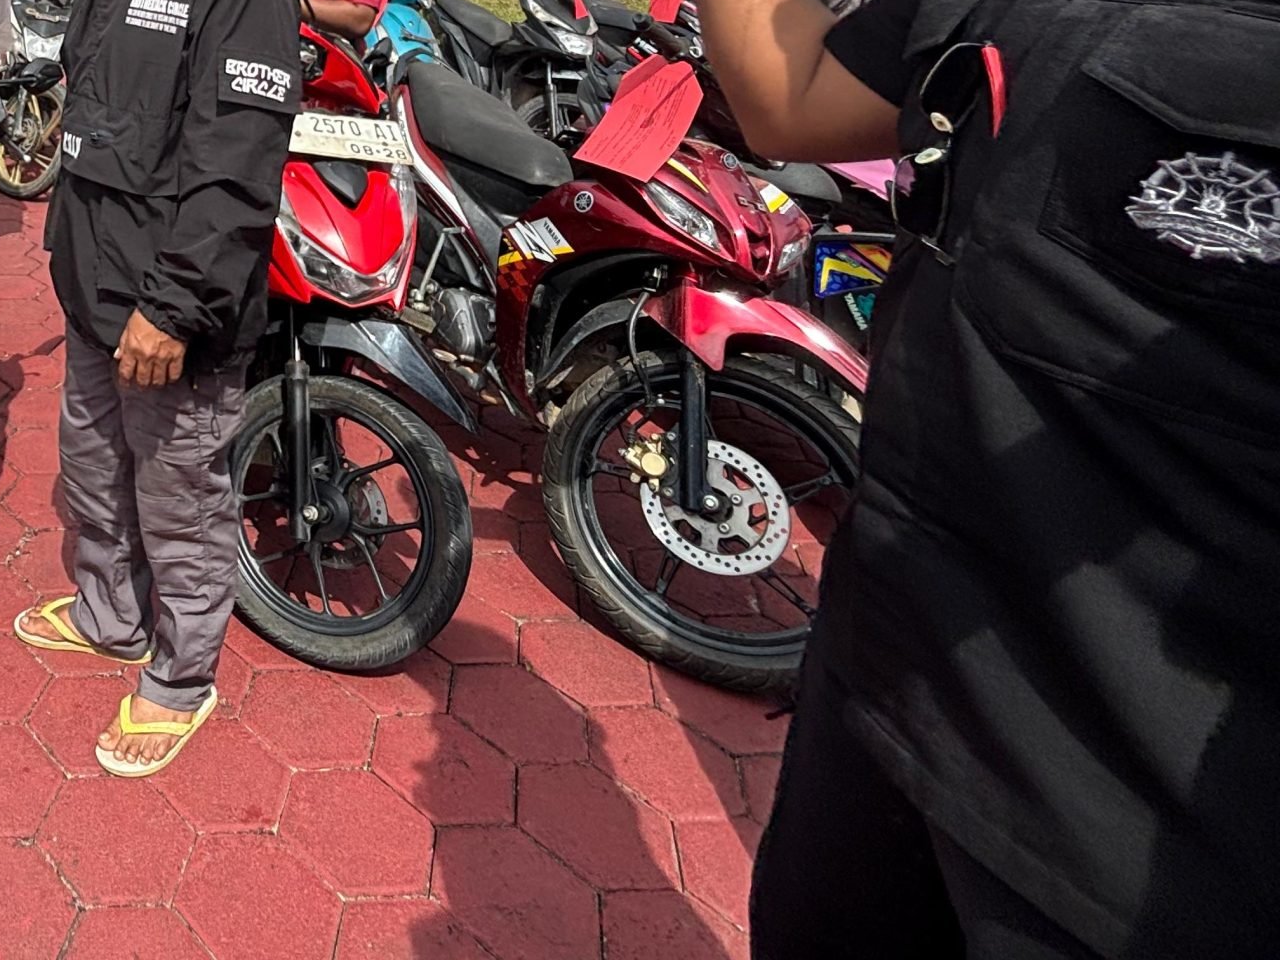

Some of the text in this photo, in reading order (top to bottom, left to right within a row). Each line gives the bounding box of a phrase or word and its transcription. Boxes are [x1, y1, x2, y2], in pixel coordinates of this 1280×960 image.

[225, 58, 291, 89] BROTHER
[231, 76, 286, 103] CIRCLE
[309, 116, 362, 137] 2570
[374, 123, 399, 141] AI
[543, 221, 562, 246] YAMAHA
[843, 292, 869, 331] YAMAHA
